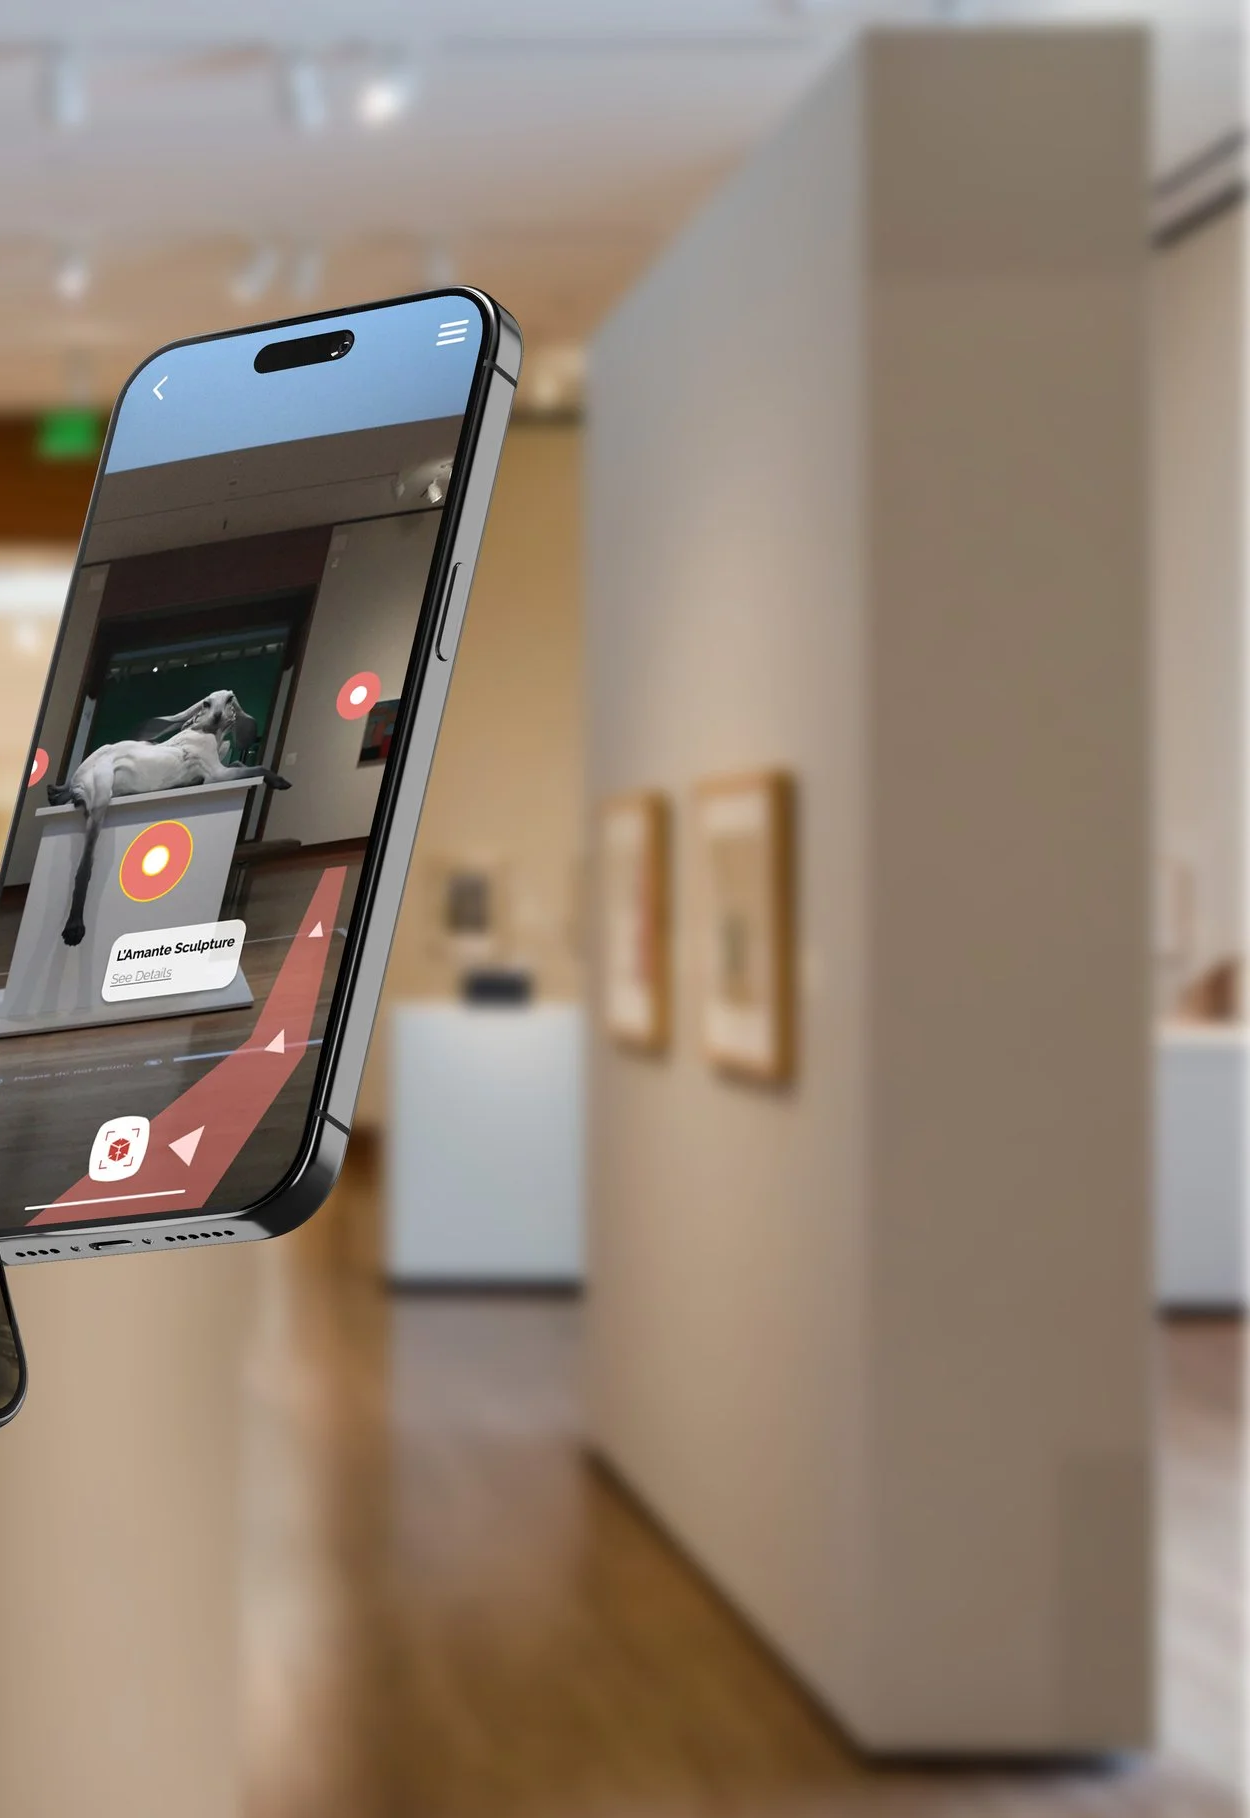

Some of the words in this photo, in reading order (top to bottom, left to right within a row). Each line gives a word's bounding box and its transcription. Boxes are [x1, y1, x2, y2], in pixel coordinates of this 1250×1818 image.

[116, 945, 172, 961] L'Amante
[174, 938, 235, 954] Sculpture
[110, 973, 133, 985] See
[135, 967, 172, 982] Details
